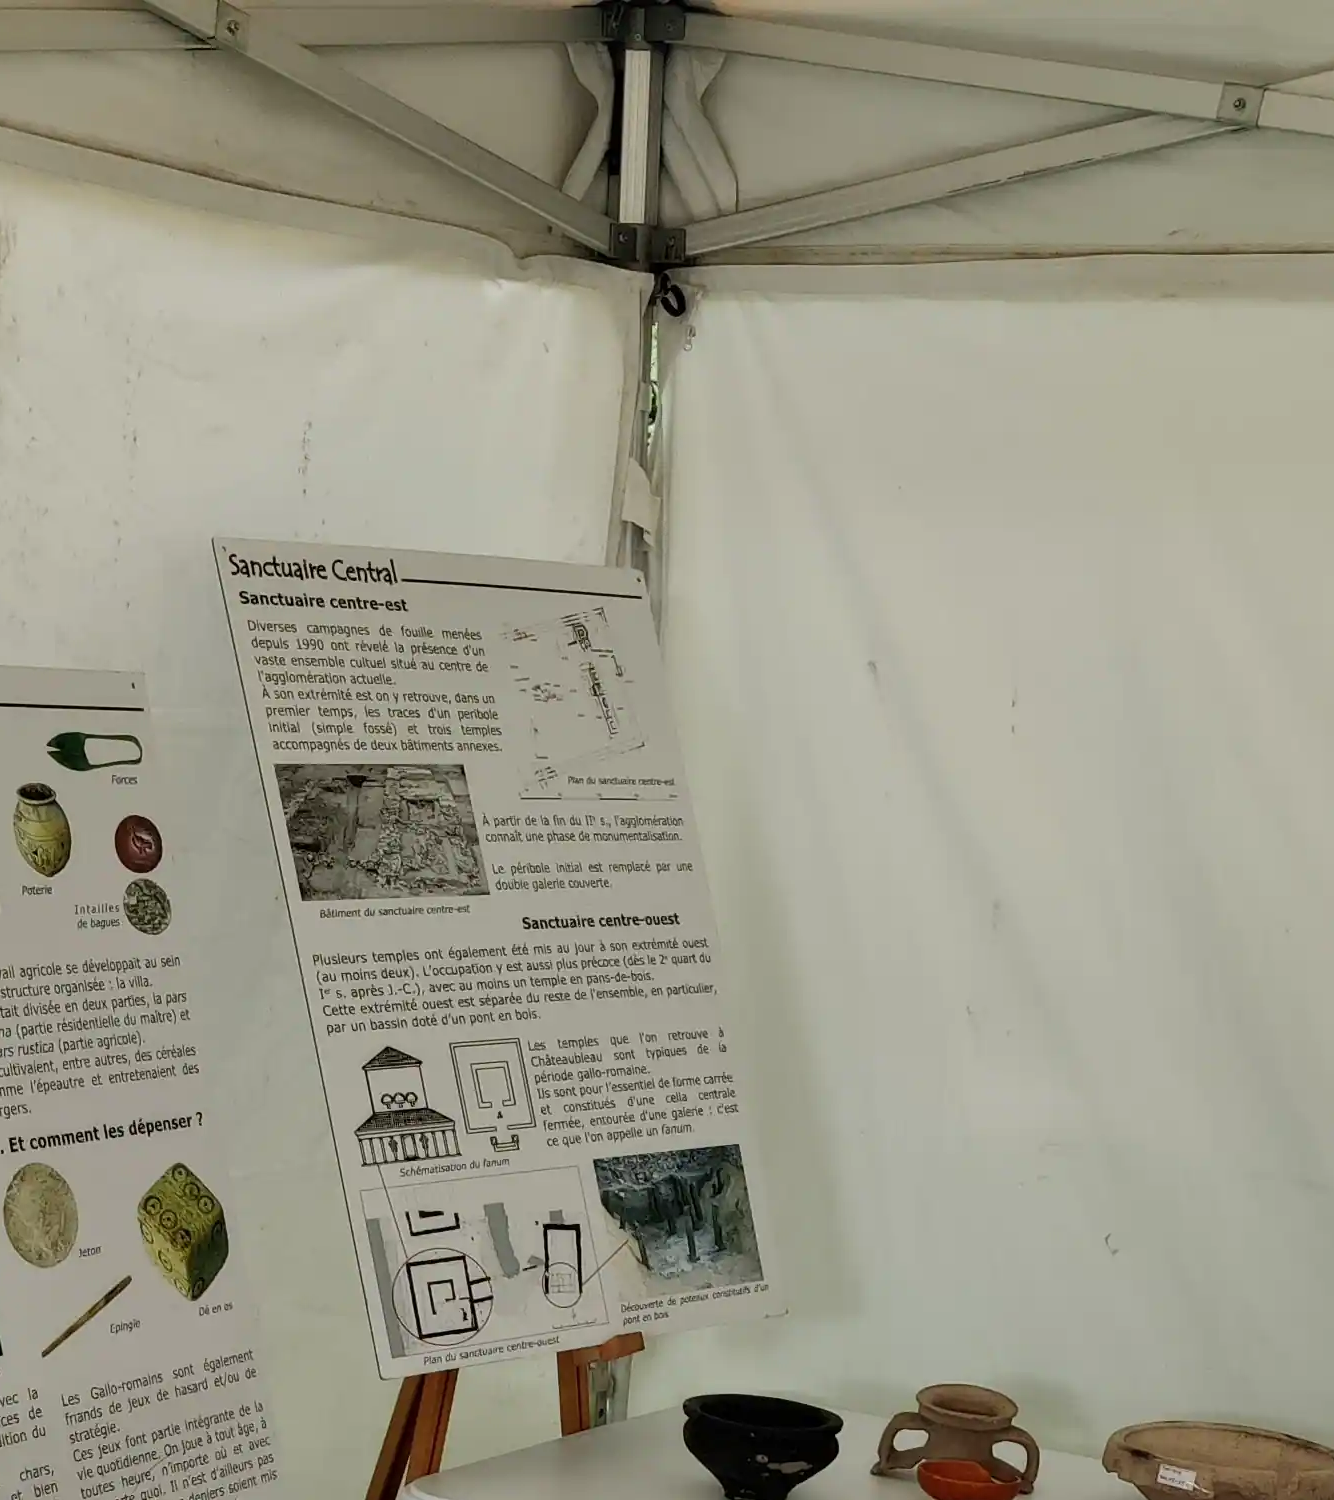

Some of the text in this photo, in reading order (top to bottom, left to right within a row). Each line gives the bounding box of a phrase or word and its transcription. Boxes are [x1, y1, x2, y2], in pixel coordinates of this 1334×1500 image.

[228, 553, 399, 586] Sanctuaire Central
[238, 590, 409, 612] Sanctuaire centre-est
[247, 619, 298, 634] Diverses
[306, 624, 371, 638] campagnes
[378, 624, 393, 637] de
[400, 624, 435, 639] fouille
[250, 635, 290, 652] depuis
[295, 637, 325, 651] 1990
[330, 640, 351, 652] ont
[393, 641, 405, 654] la
[462, 643, 486, 657] d'un
[521, 912, 681, 930] Sanctuaire centre-ouest
[8, 1136, 27, 1153] Et
[29, 1126, 101, 1150] comment
[102, 1123, 125, 1140] les
[128, 1116, 193, 1138] dépenser
